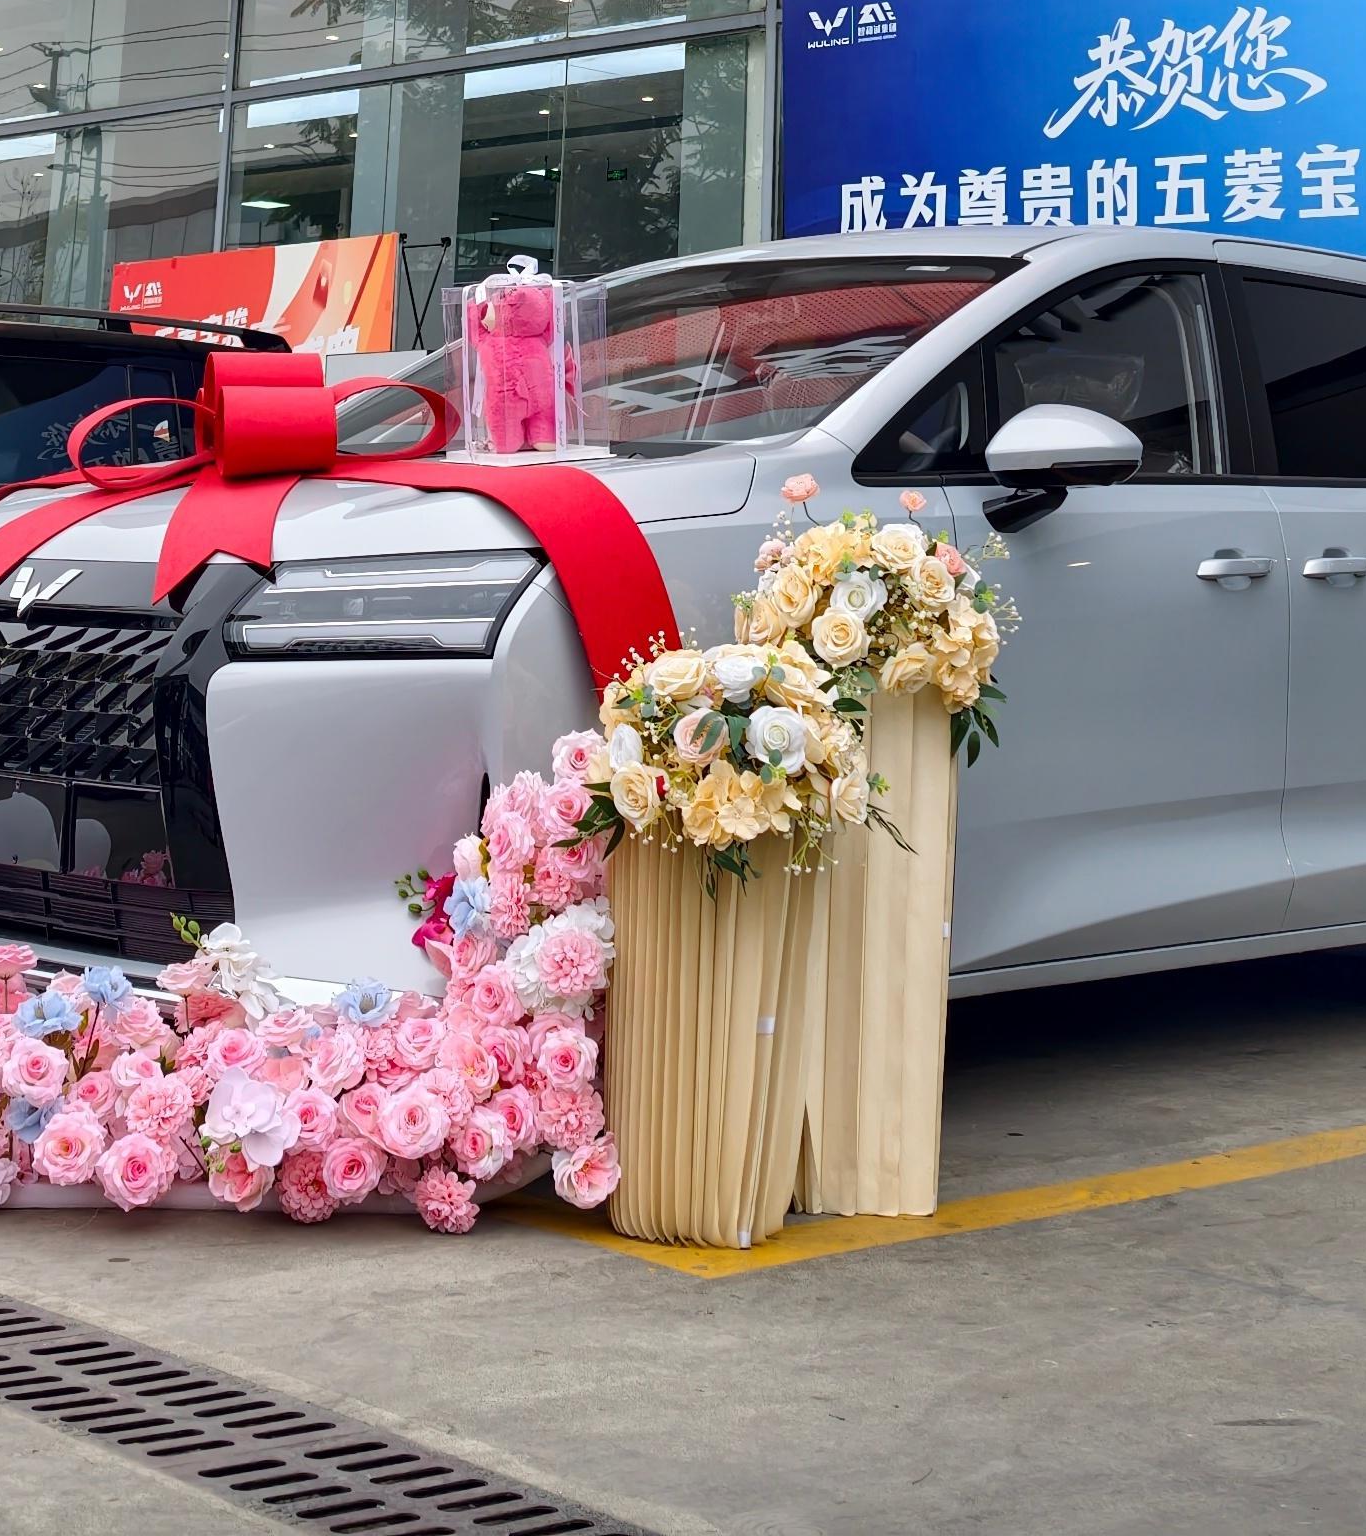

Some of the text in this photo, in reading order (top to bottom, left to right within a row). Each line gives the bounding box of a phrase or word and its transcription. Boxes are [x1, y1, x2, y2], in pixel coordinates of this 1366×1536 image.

[807, 37, 850, 49] WULING
[1043, 6, 1327, 139] 恭贺您
